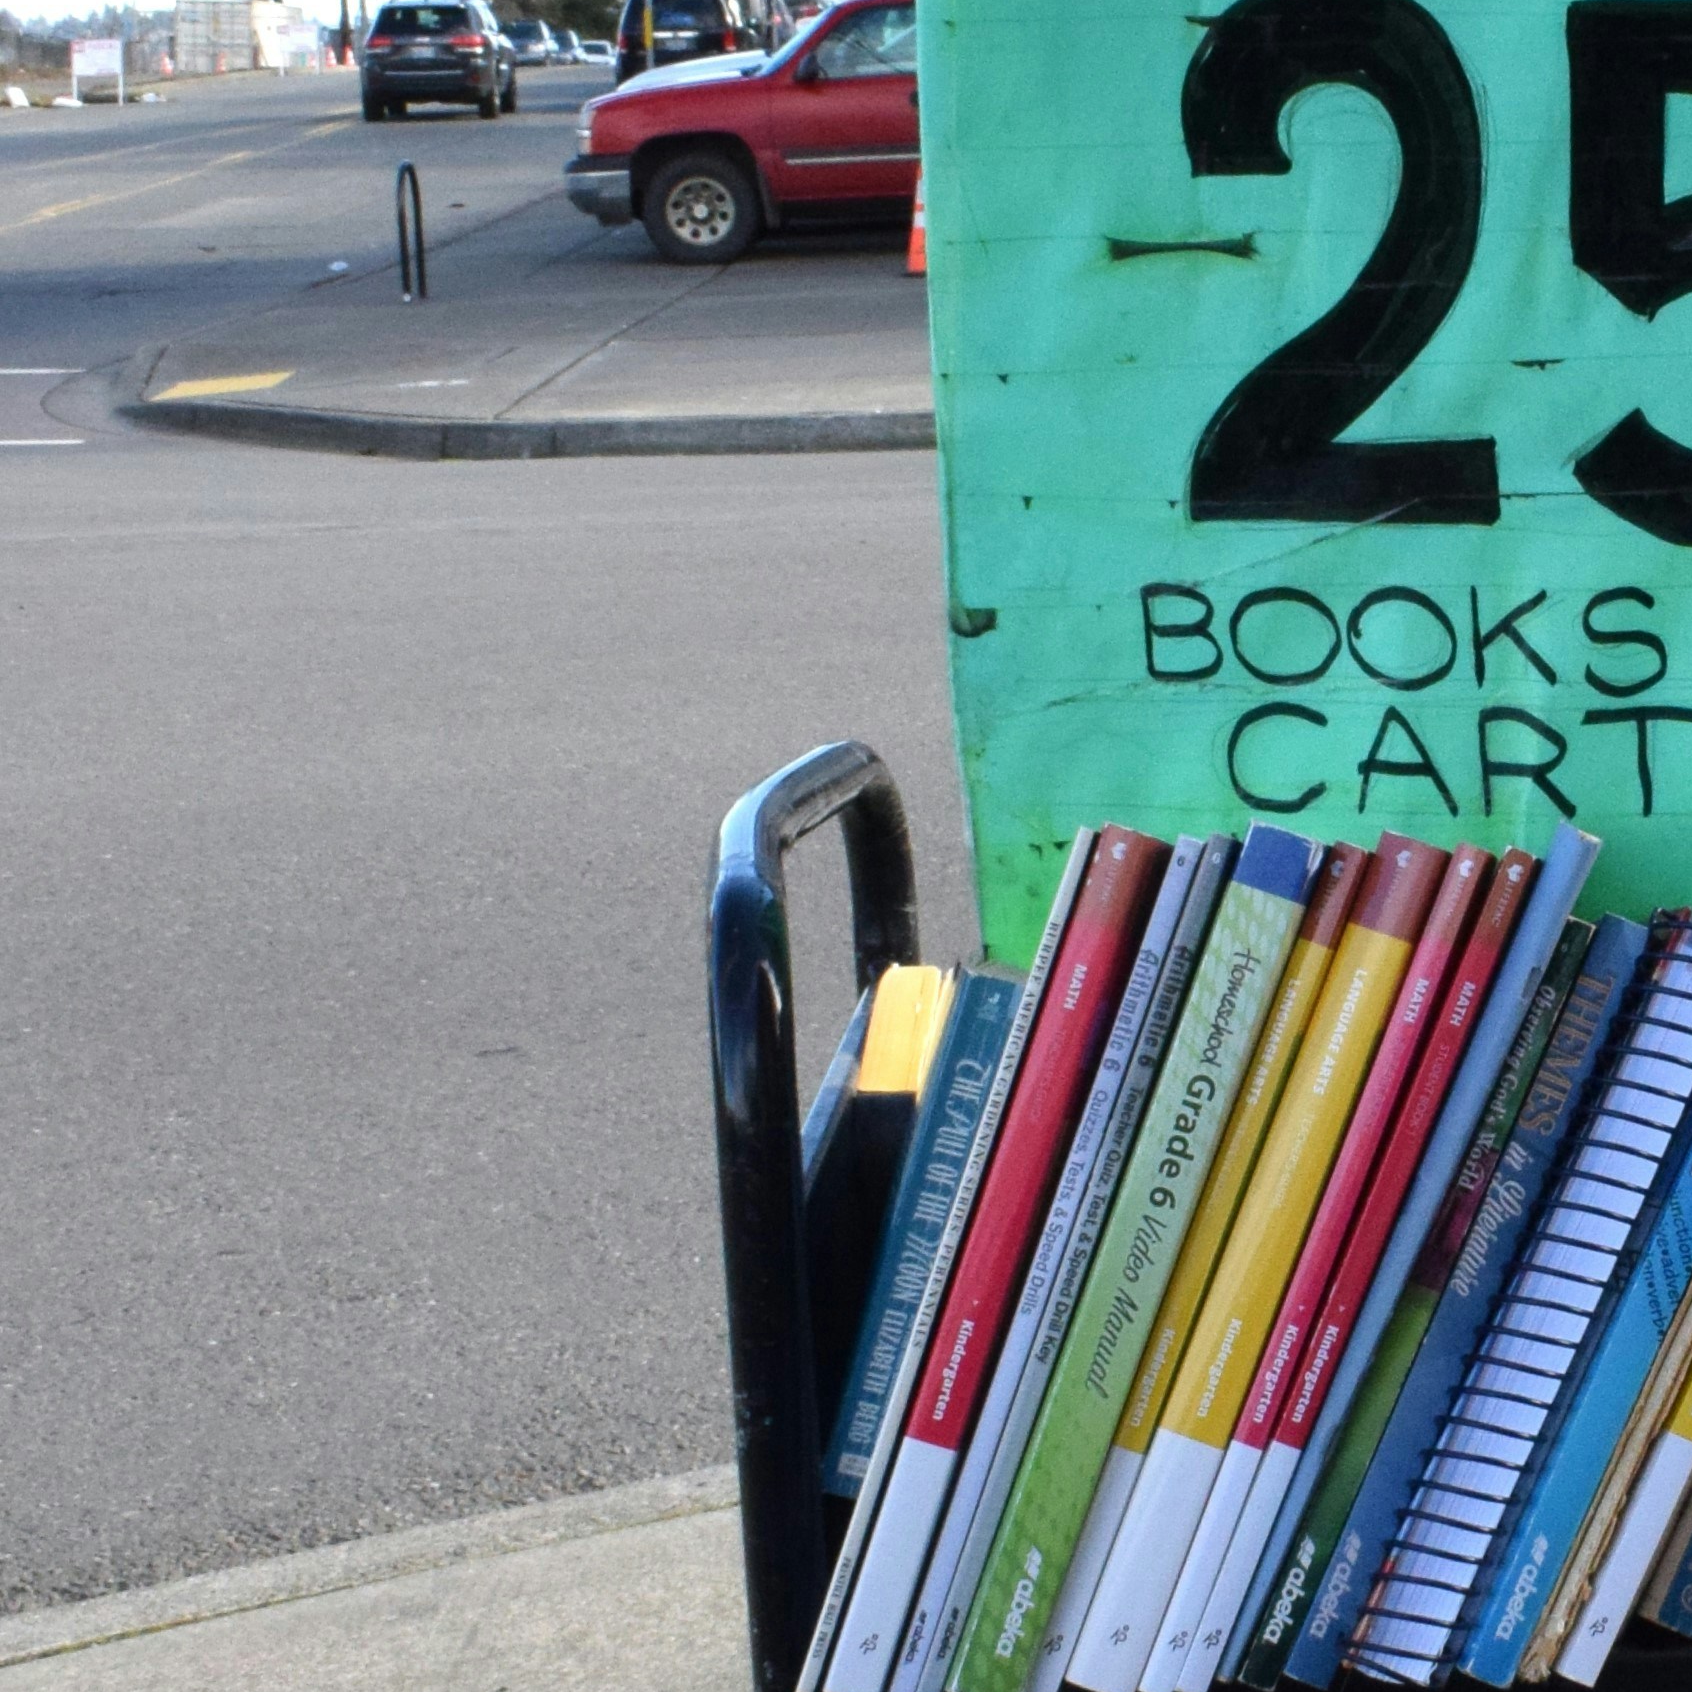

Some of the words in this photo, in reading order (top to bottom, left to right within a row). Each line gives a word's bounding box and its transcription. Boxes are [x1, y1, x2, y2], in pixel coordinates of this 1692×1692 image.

[1140, 583, 1668, 695] BOOKS
[1061, 962, 1088, 1011] MATH
[1197, 946, 1262, 1070] Homeschool
[1259, 977, 1300, 1063] LANGUAGE
[1326, 967, 1369, 1054] LANGUAGE
[1401, 976, 1430, 1024] MATH
[1245, 1064, 1269, 1106] ARTS
[1310, 1054, 1336, 1096] ARTS
[1157, 1070, 1219, 1182] Grade
[1146, 1184, 1179, 1212] 6
[1119, 1212, 1169, 1288] Video
[929, 1317, 977, 1419] Kindergarten
[1081, 1287, 1142, 1398] Manual
[1127, 1326, 1176, 1429] Kindergarten
[1191, 1315, 1243, 1418] Kindergarten
[1249, 1322, 1301, 1425] Kindergarten
[1288, 1322, 1342, 1425] Kindergarten
[992, 1577, 1040, 1660] abeka
[1259, 1565, 1311, 1647] abeka
[1307, 1558, 1359, 1641] abeka
[1493, 1562, 1544, 1643] abeka
